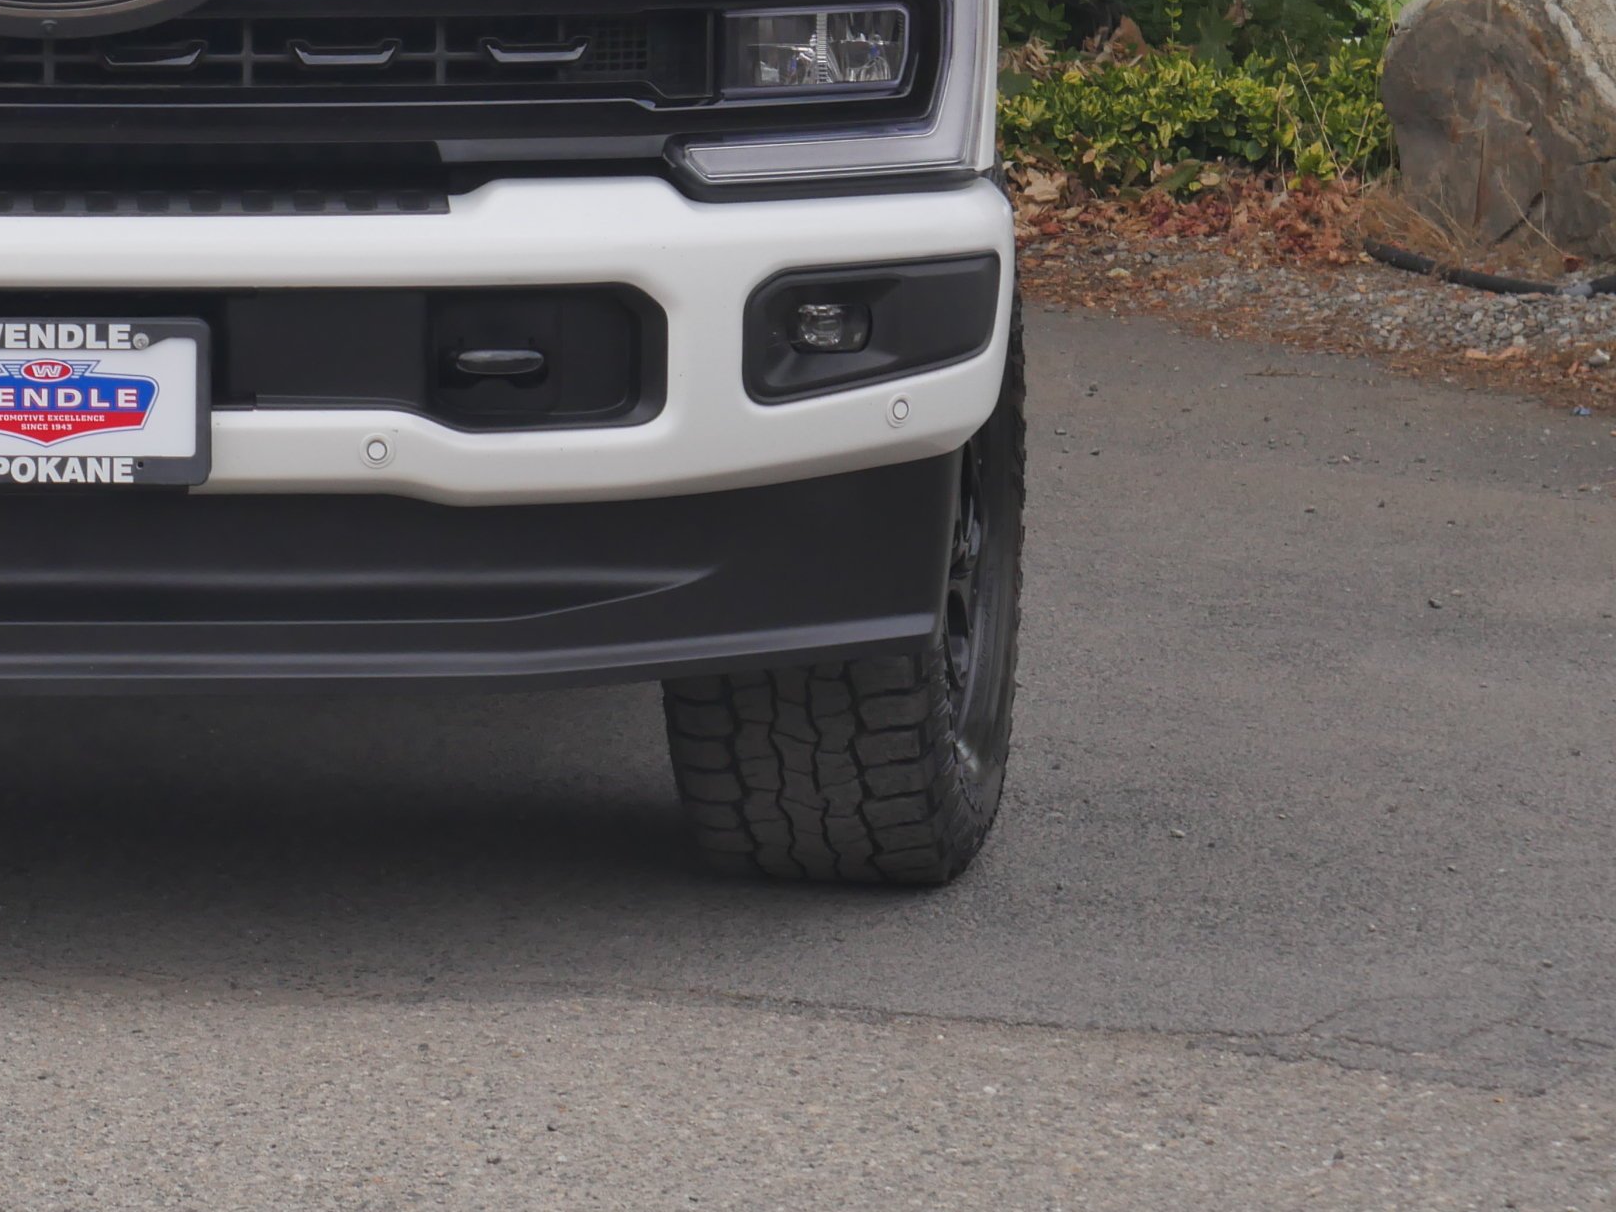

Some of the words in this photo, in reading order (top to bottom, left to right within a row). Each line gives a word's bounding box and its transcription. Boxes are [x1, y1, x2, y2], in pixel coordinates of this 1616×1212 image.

[47, 414, 105, 422] EXCELLENCE
[21, 423, 49, 431] SINCE
[51, 423, 73, 431] 1943
